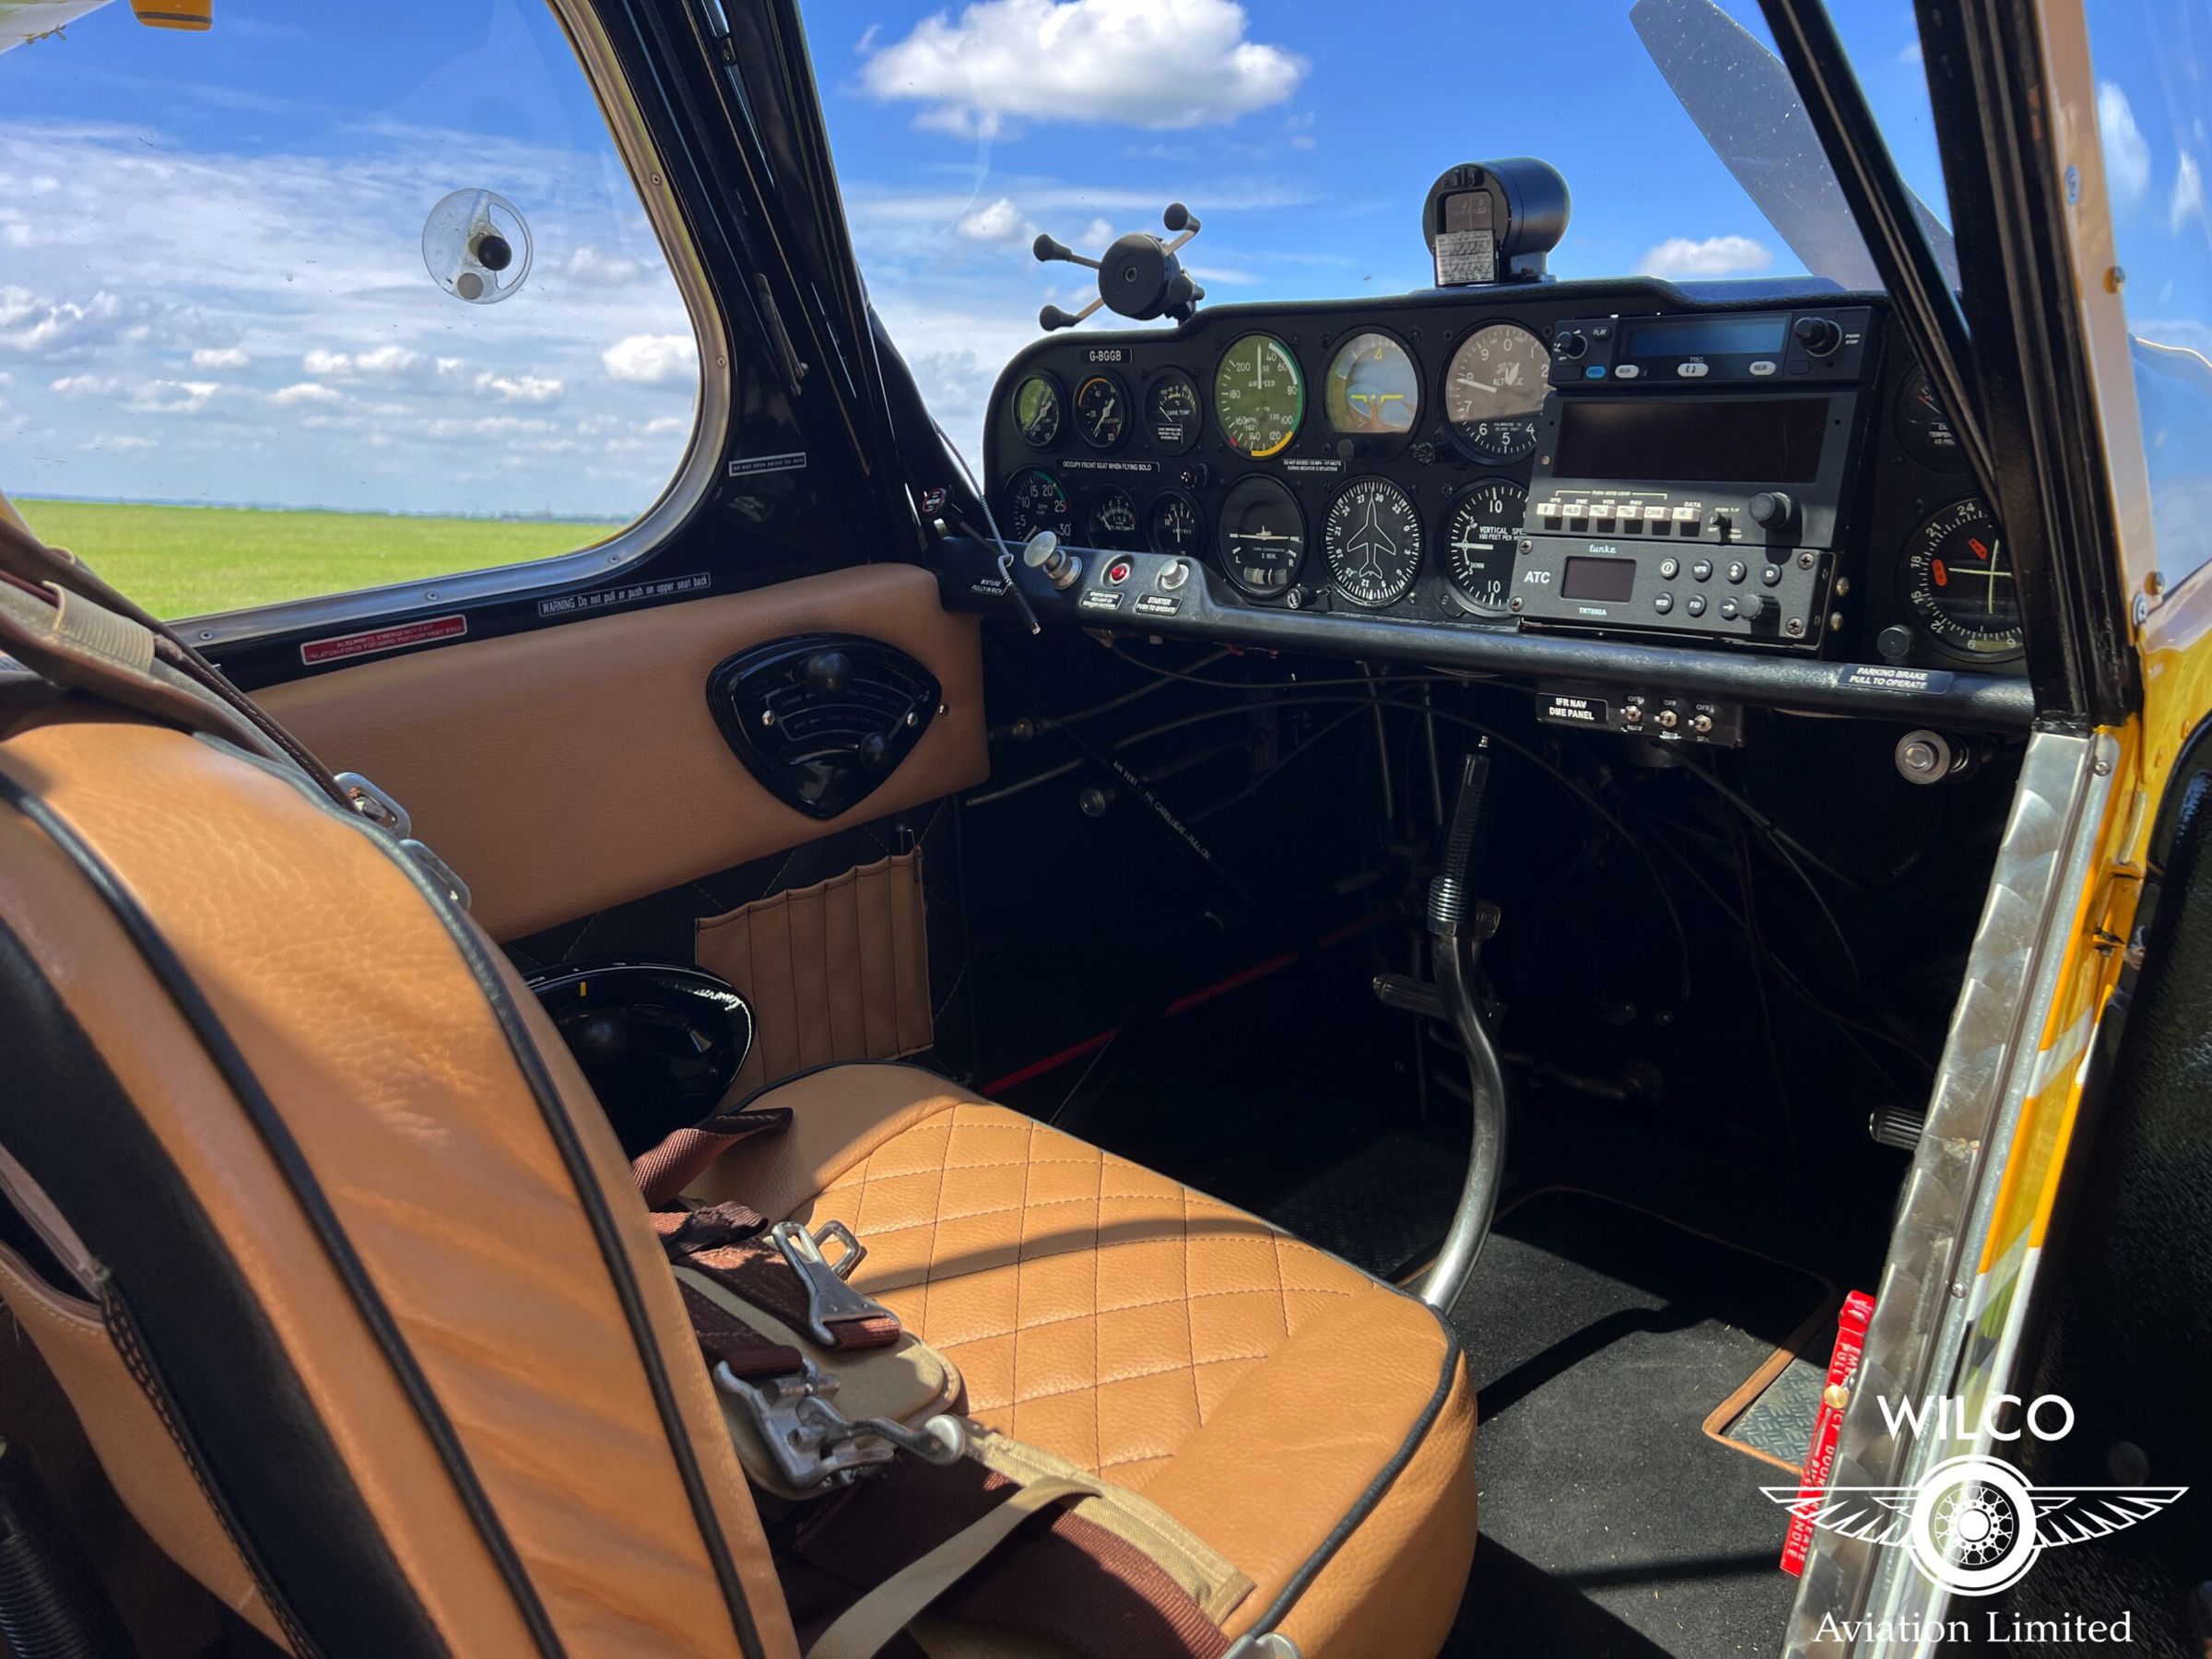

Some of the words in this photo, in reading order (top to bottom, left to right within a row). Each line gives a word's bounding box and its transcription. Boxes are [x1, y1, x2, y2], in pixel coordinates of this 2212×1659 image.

[1503, 338, 1512, 351] 0
[1089, 350, 1122, 362] G-BGGB
[1266, 353, 1277, 361] 40
[1481, 348, 1489, 361] 9
[1531, 347, 1534, 359] 1
[1236, 362, 1251, 371] 200
[1541, 364, 1549, 377] 2
[1229, 389, 1241, 399] 180
[1288, 385, 1298, 395] 80
[1465, 401, 1472, 413] 7
[1281, 416, 1293, 424] 100
[1479, 423, 1488, 436] 6
[1525, 423, 1535, 435] 4
[1249, 431, 1261, 441] 140
[1269, 431, 1281, 441] 120
[1502, 432, 1511, 445] 5
[1030, 485, 1039, 498] 15
[1042, 485, 1053, 498] 20
[1375, 493, 1383, 502] 30
[1021, 496, 1030, 508] 10
[1357, 494, 1365, 504] 27
[1054, 500, 1065, 512] 25
[1342, 505, 1350, 517] 24
[1392, 503, 1401, 514] 33
[1489, 500, 1502, 513] 10
[1957, 502, 1975, 516] 24
[1019, 514, 1027, 527] 5
[1059, 524, 1071, 535] 30
[1335, 526, 1342, 536] 21
[1479, 525, 1508, 535] VERTICAL
[1925, 522, 1942, 537] 21
[1478, 533, 1488, 541] 100
[1335, 547, 1344, 559] 18
[1235, 556, 1241, 564] L
[1910, 555, 1922, 569] 18
[1694, 565, 1708, 573] VFR
[980, 579, 1001, 587] MIXTURE
[1361, 578, 1370, 587] 12
[1524, 571, 1551, 583] ATC
[1488, 581, 1500, 593] 10
[542, 598, 576, 613] WARNING
[578, 597, 588, 606] Do
[590, 595, 601, 606] not
[604, 592, 616, 604] pull
[629, 588, 643, 600] push
[657, 582, 675, 594] upper
[677, 580, 691, 590] seat
[693, 575, 708, 587] back
[1911, 590, 1923, 605] 15
[1147, 596, 1171, 606] STARTER
[1155, 606, 1176, 614] OPERATE
[1931, 620, 1945, 633] 12
[1857, 667, 1895, 677] PARKING
[1896, 670, 1928, 680] BRAKE
[1849, 676, 1871, 685] PULL
[1886, 678, 1928, 689] OPERATE
[1555, 697, 1570, 707] IFR
[1570, 699, 1587, 709] NAV
[1548, 706, 1567, 717] DME
[1568, 709, 1594, 721] PANEL
[1830, 1342, 1848, 1380] PULL
